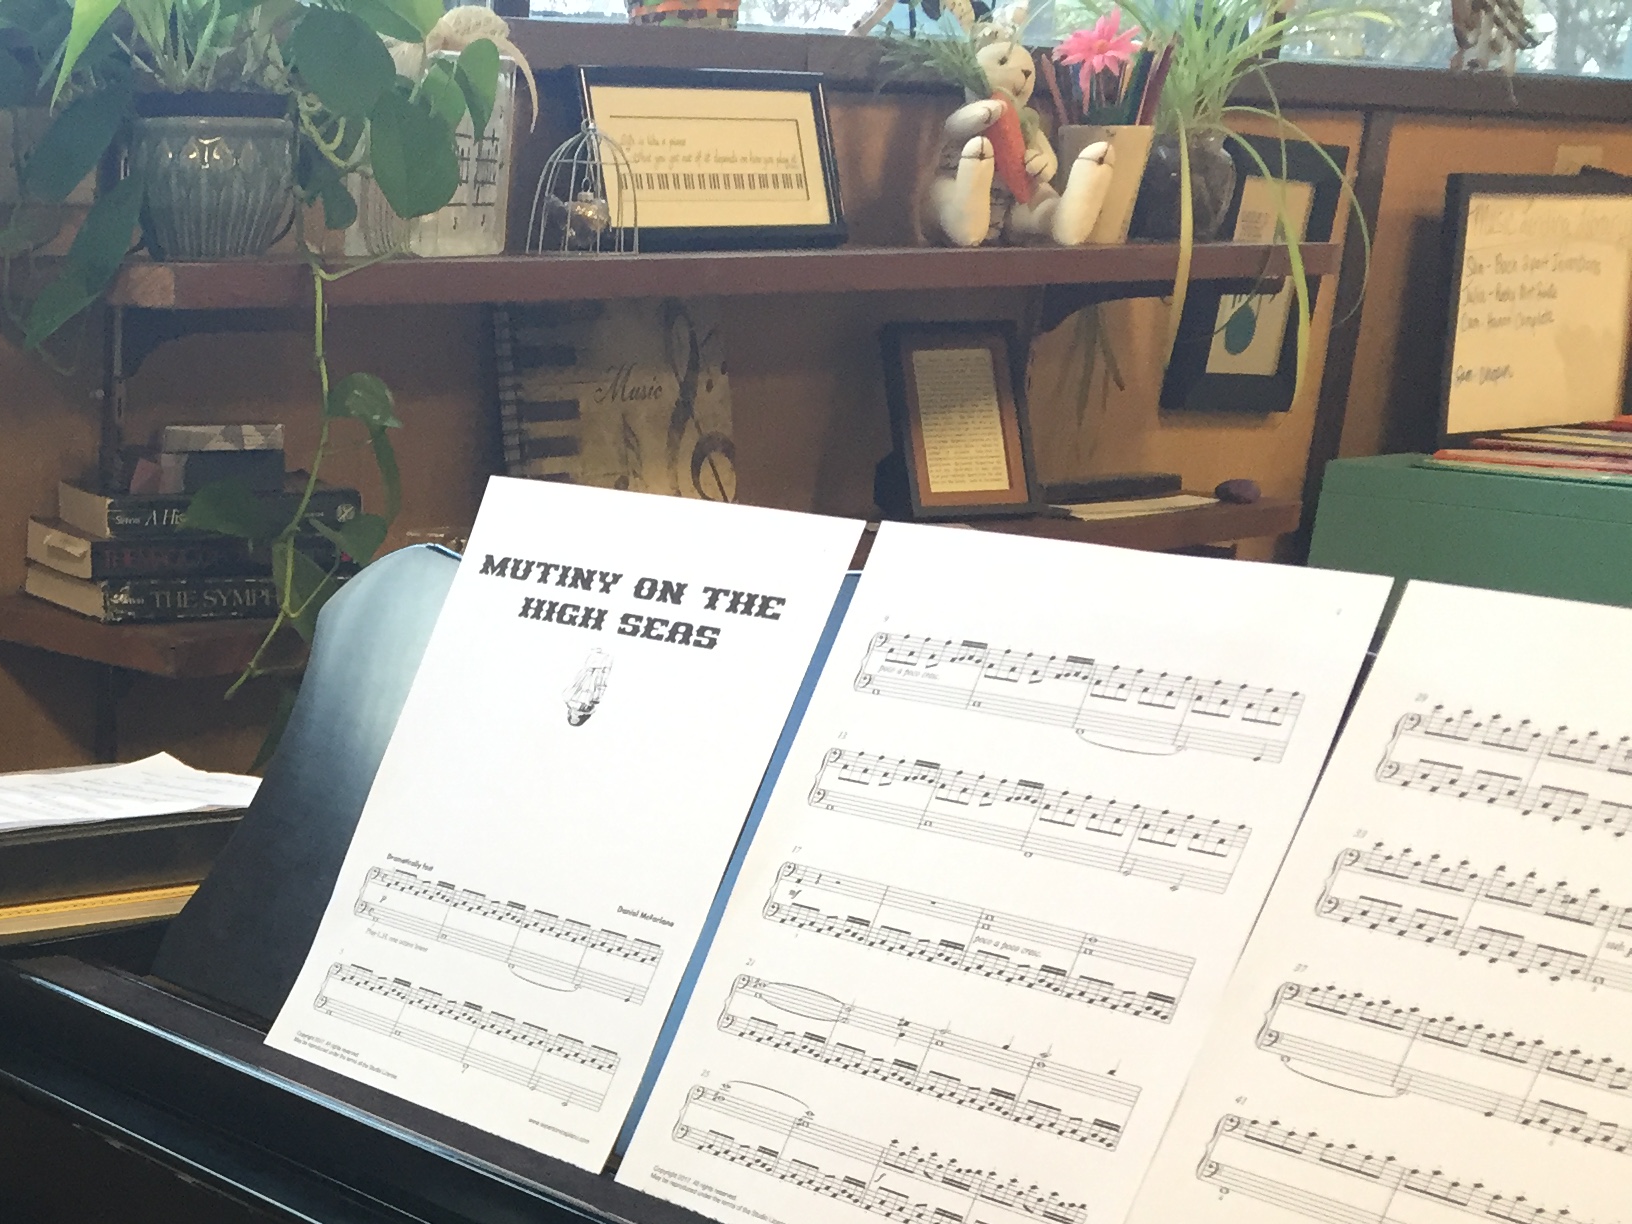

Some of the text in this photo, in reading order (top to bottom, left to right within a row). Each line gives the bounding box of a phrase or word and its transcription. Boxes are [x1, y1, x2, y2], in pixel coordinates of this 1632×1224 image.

[593, 362, 663, 404] Music
[150, 589, 196, 608] THE
[479, 554, 786, 621] MUTINY ON THE
[518, 597, 721, 650] HIGH SEAS
